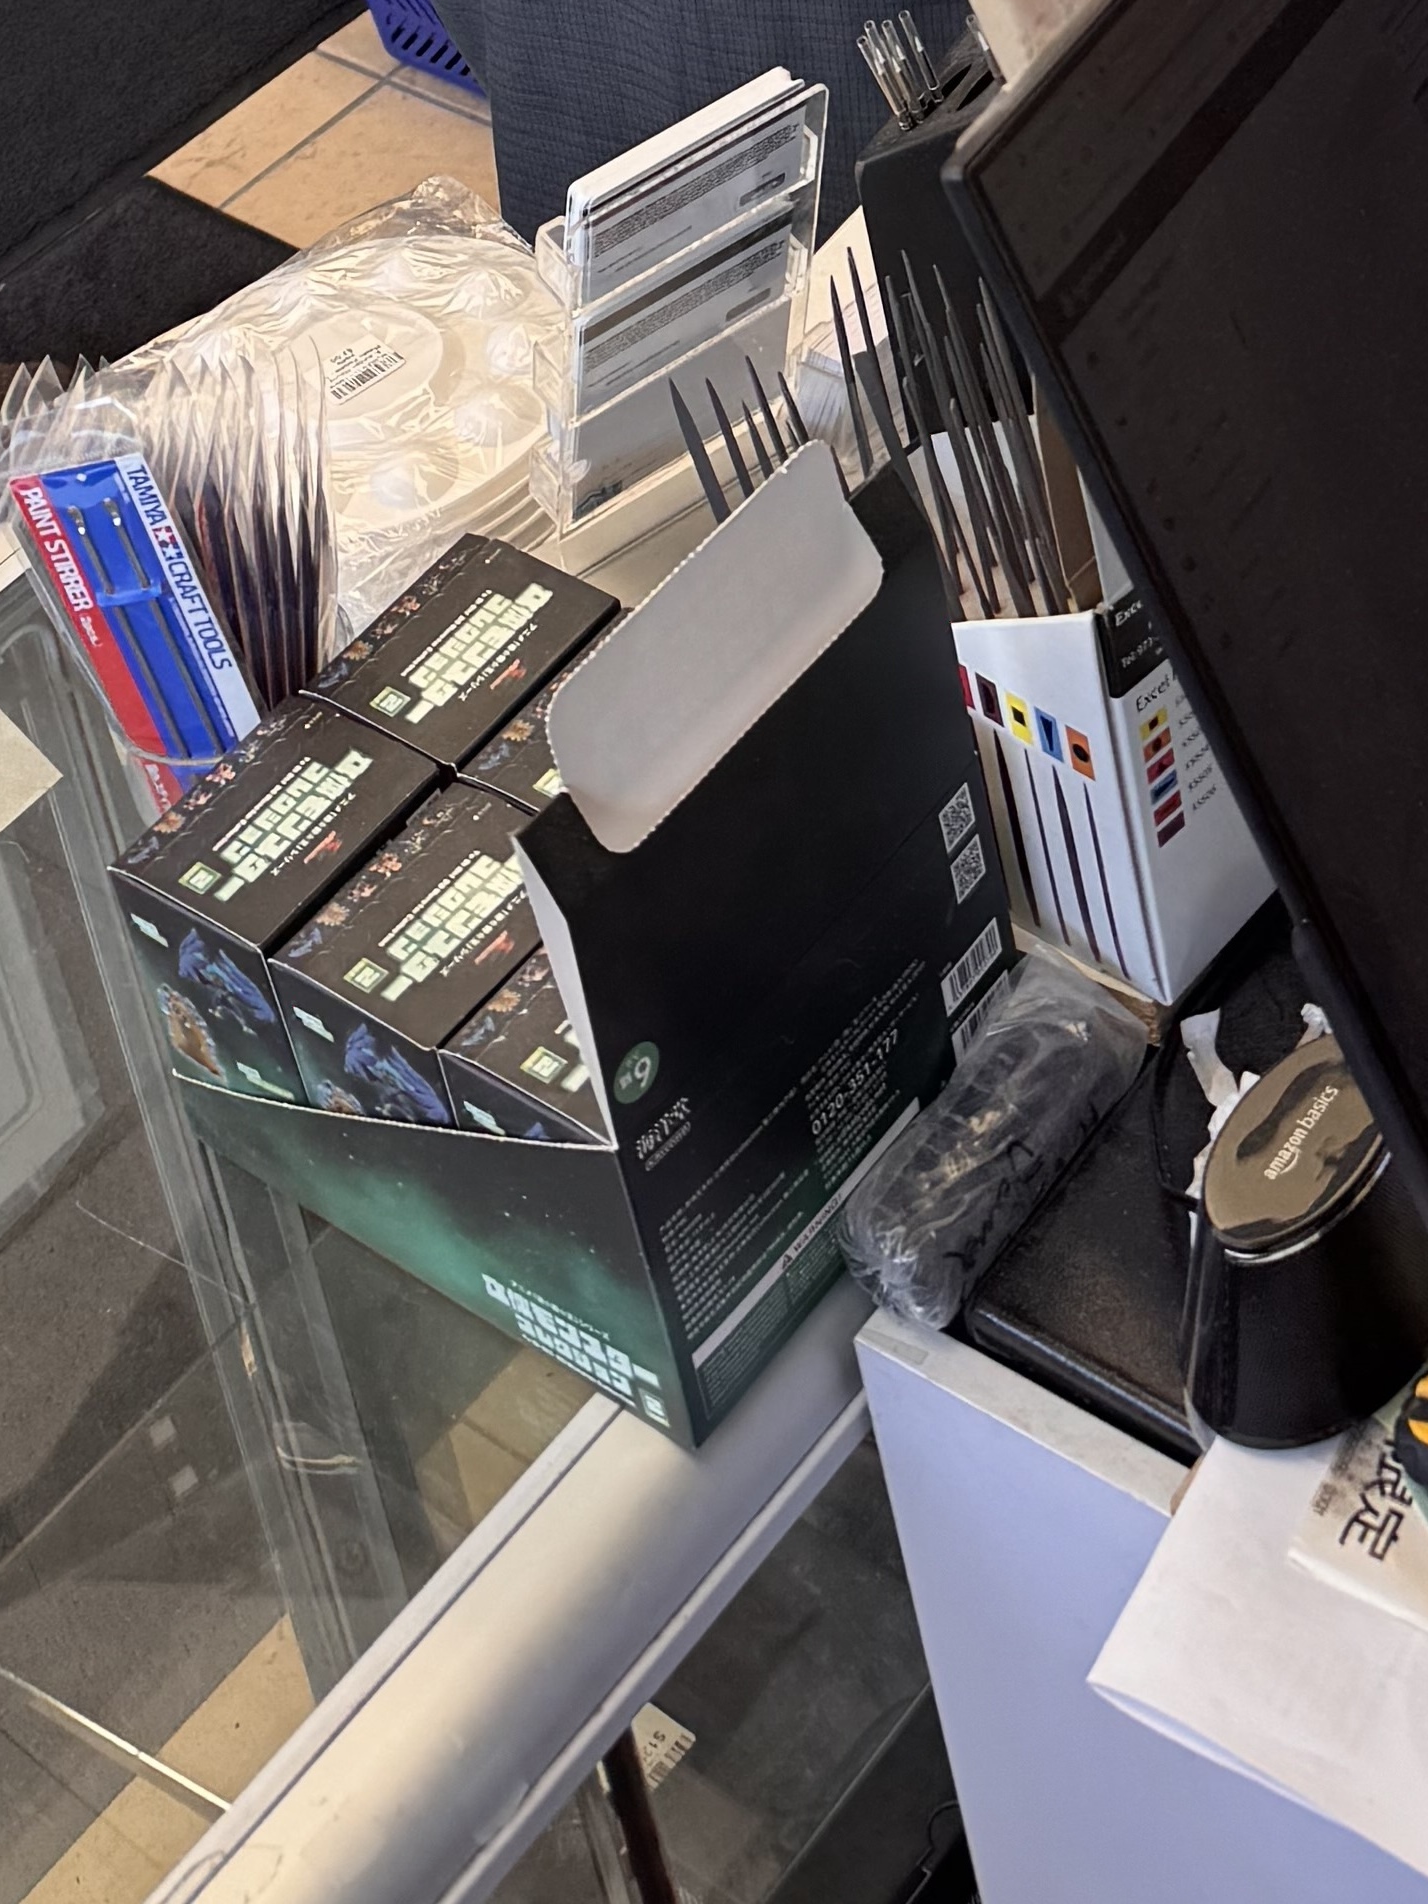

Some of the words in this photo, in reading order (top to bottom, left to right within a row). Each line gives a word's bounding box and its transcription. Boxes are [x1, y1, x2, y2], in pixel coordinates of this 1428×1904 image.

[18, 485, 56, 545] PAINT
[39, 534, 94, 612] STIRRER
[124, 462, 167, 529] TAMIYA
[169, 547, 210, 626] CRAFT
[195, 616, 234, 672] TOOLS
[1134, 675, 1172, 713] Excel
[1263, 1129, 1305, 1182] amazon
[1303, 1085, 1339, 1133] basics
[791, 1192, 843, 1255] WARNING!
